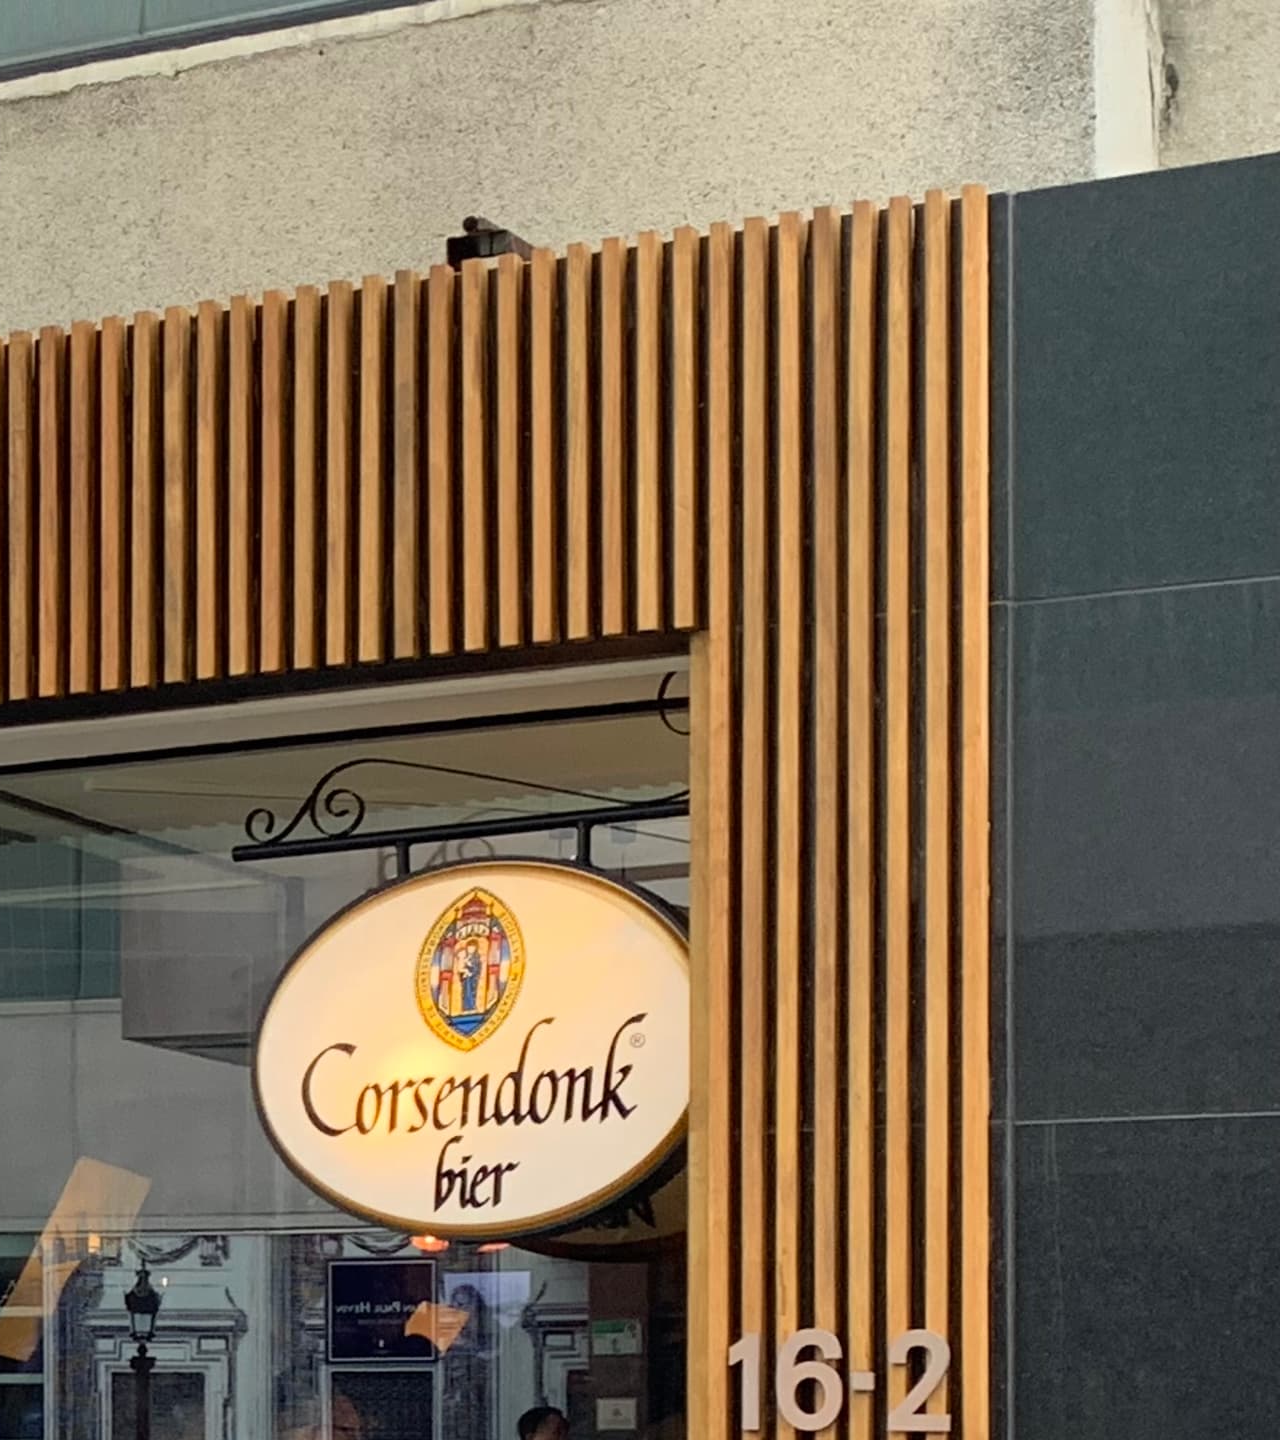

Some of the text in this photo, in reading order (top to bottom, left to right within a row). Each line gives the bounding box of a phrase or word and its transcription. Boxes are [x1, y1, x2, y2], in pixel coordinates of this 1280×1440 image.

[301, 1012, 648, 1137] Corsendonk
[434, 1135, 520, 1212] bier
[728, 1327, 952, 1432] 16-2
